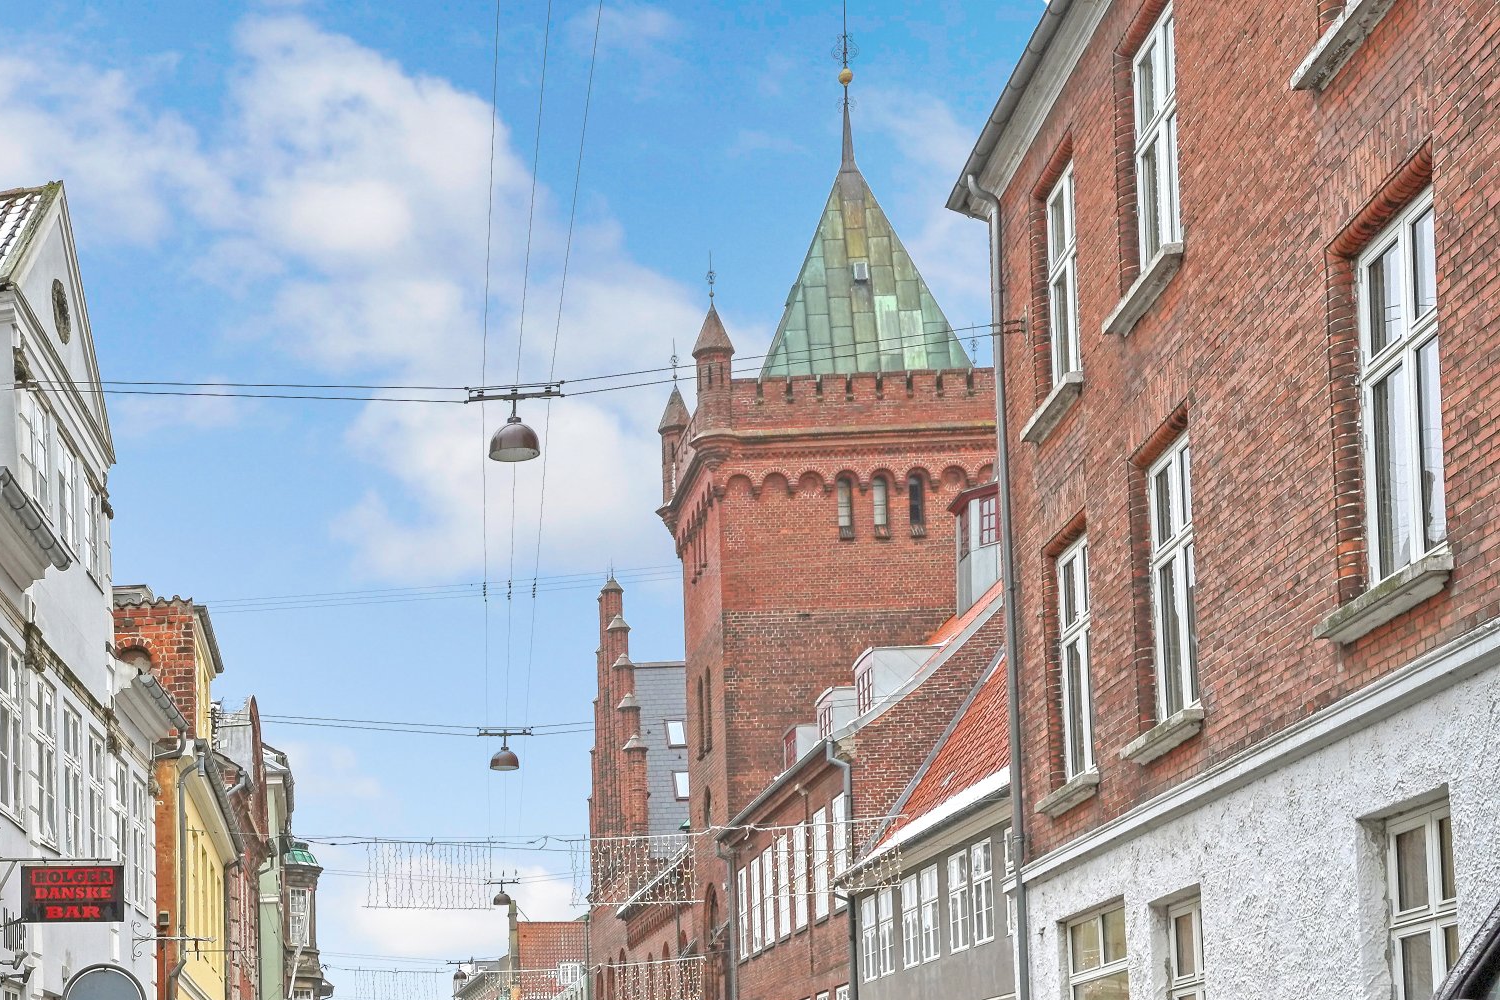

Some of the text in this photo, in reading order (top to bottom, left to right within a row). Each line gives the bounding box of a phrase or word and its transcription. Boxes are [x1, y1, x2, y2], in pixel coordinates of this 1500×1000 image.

[35, 871, 112, 883] HOLGER
[35, 886, 112, 900] DANSKE
[46, 905, 100, 919] BAR
